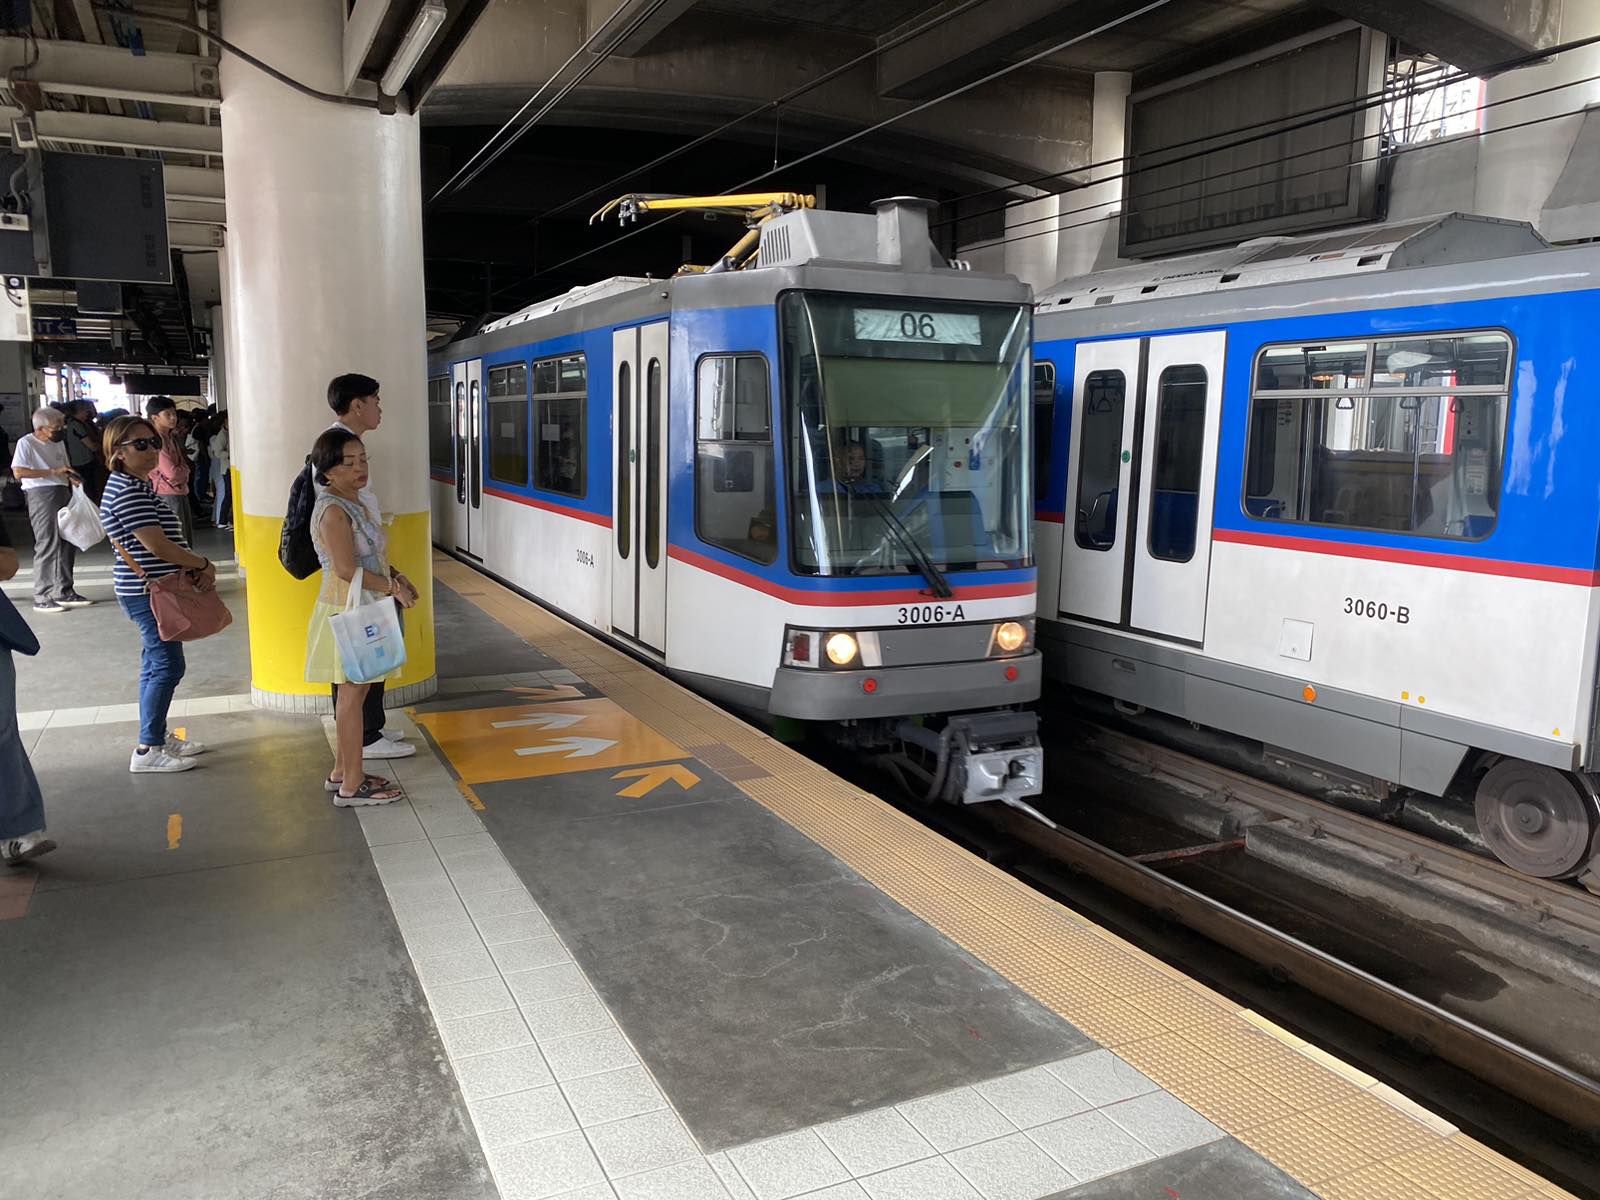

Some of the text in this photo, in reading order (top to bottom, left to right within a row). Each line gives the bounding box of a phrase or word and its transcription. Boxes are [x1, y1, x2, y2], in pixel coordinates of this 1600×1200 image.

[901, 312, 935, 339] 06
[898, 604, 965, 624] 3006-A
[1344, 597, 1410, 624] 3060-B
